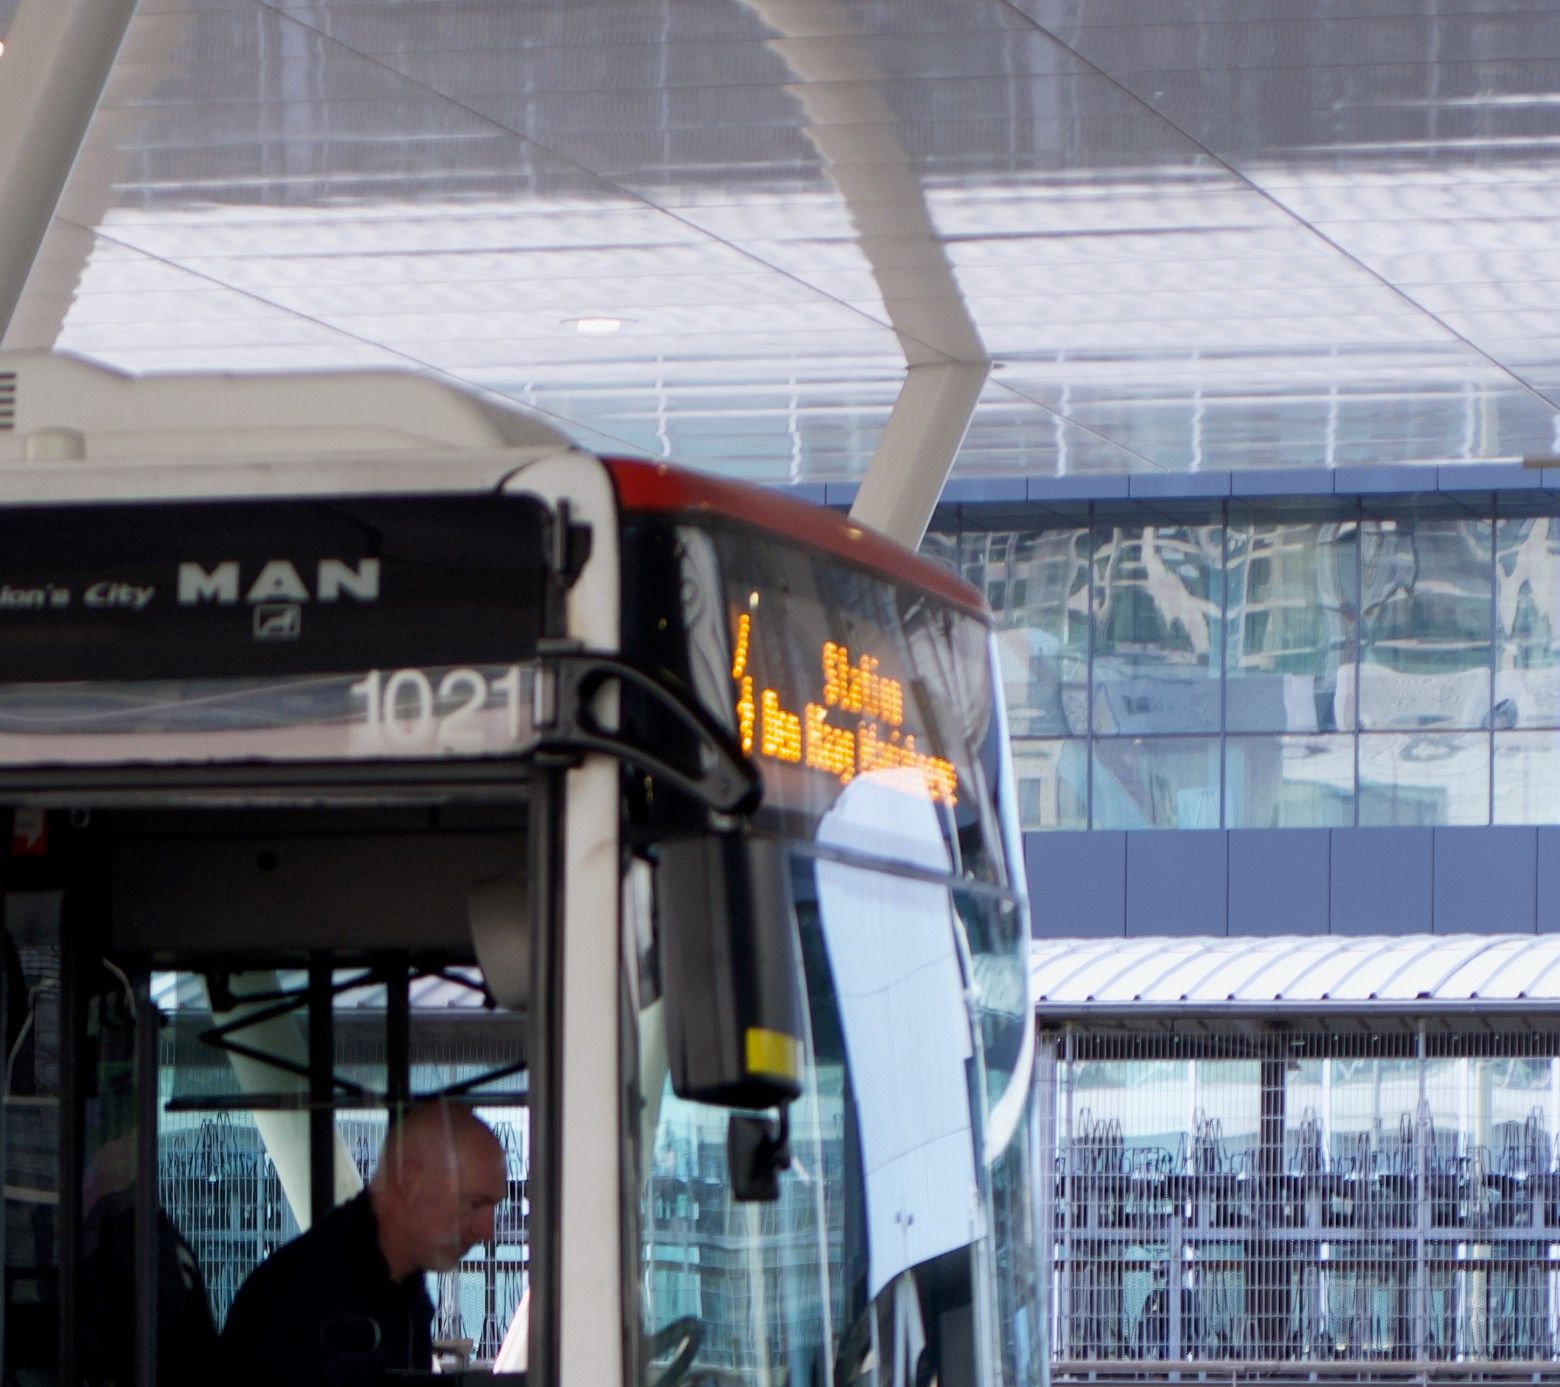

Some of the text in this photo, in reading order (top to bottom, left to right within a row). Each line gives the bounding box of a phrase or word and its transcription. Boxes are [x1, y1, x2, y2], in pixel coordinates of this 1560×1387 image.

[83, 582, 155, 611] City
[177, 557, 381, 605] MAN
[350, 665, 522, 745] 1021
